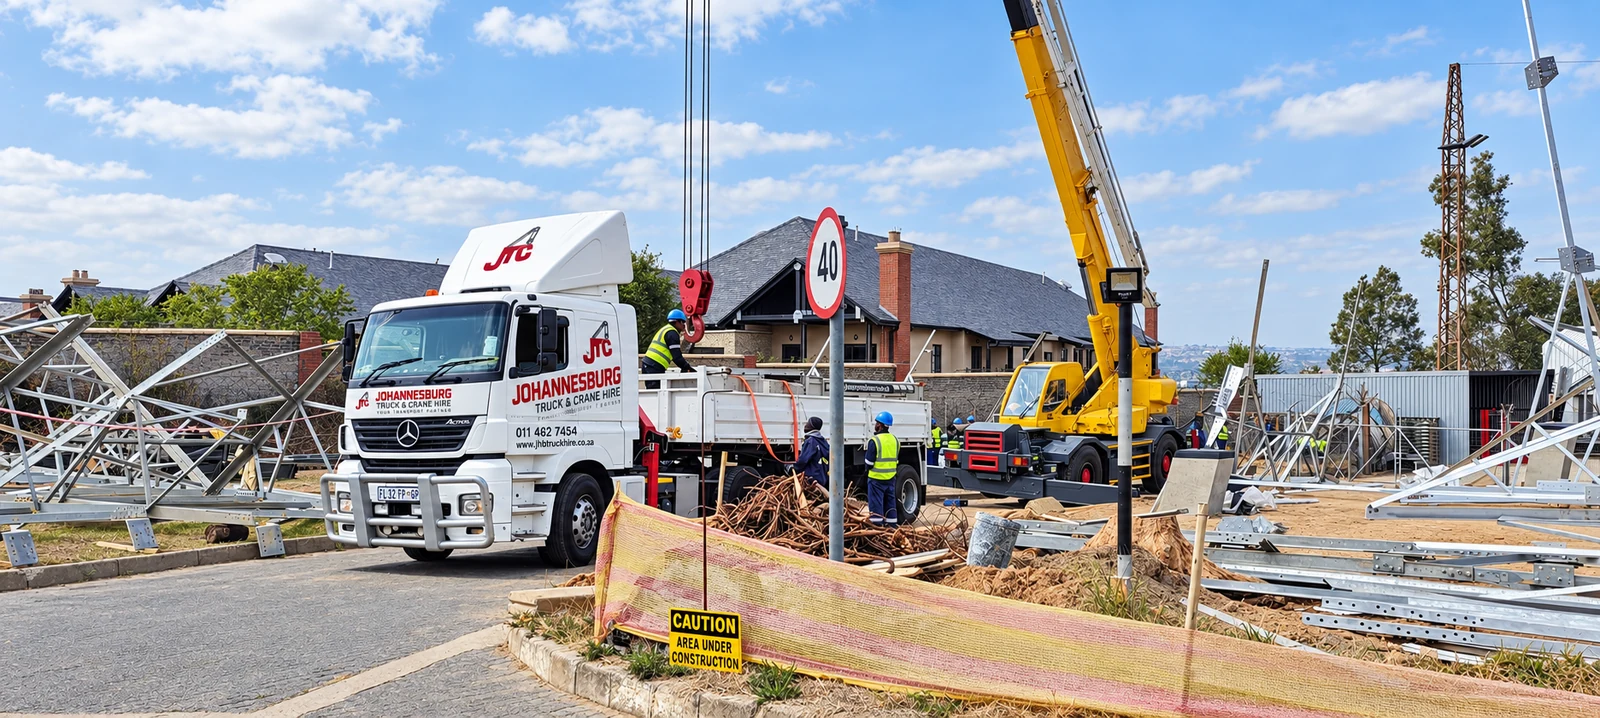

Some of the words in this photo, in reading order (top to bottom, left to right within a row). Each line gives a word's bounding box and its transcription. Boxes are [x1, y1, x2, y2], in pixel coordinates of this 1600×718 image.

[817, 240, 838, 282] 40
[375, 388, 452, 401] JOHANNESBURG
[512, 366, 621, 405] JOHANNESBURG
[376, 400, 400, 409] TRUCK
[401, 400, 407, 409] &
[408, 400, 433, 408] CRANE
[434, 399, 452, 407] HIRE
[535, 399, 564, 414] TRUCK
[565, 397, 572, 408] &
[573, 391, 601, 405] CRANE
[602, 386, 621, 400] HIRE
[516, 427, 531, 438] 011
[534, 426, 552, 437] 462
[555, 426, 577, 436] 7454
[516, 439, 594, 450] www.jhbtruckhire.co.za
[397, 488, 406, 500] FP
[672, 612, 736, 634] CAUTION
[677, 636, 699, 650] AREA
[702, 639, 732, 654] UNDER
[671, 651, 739, 670] CONSTRUCTION
